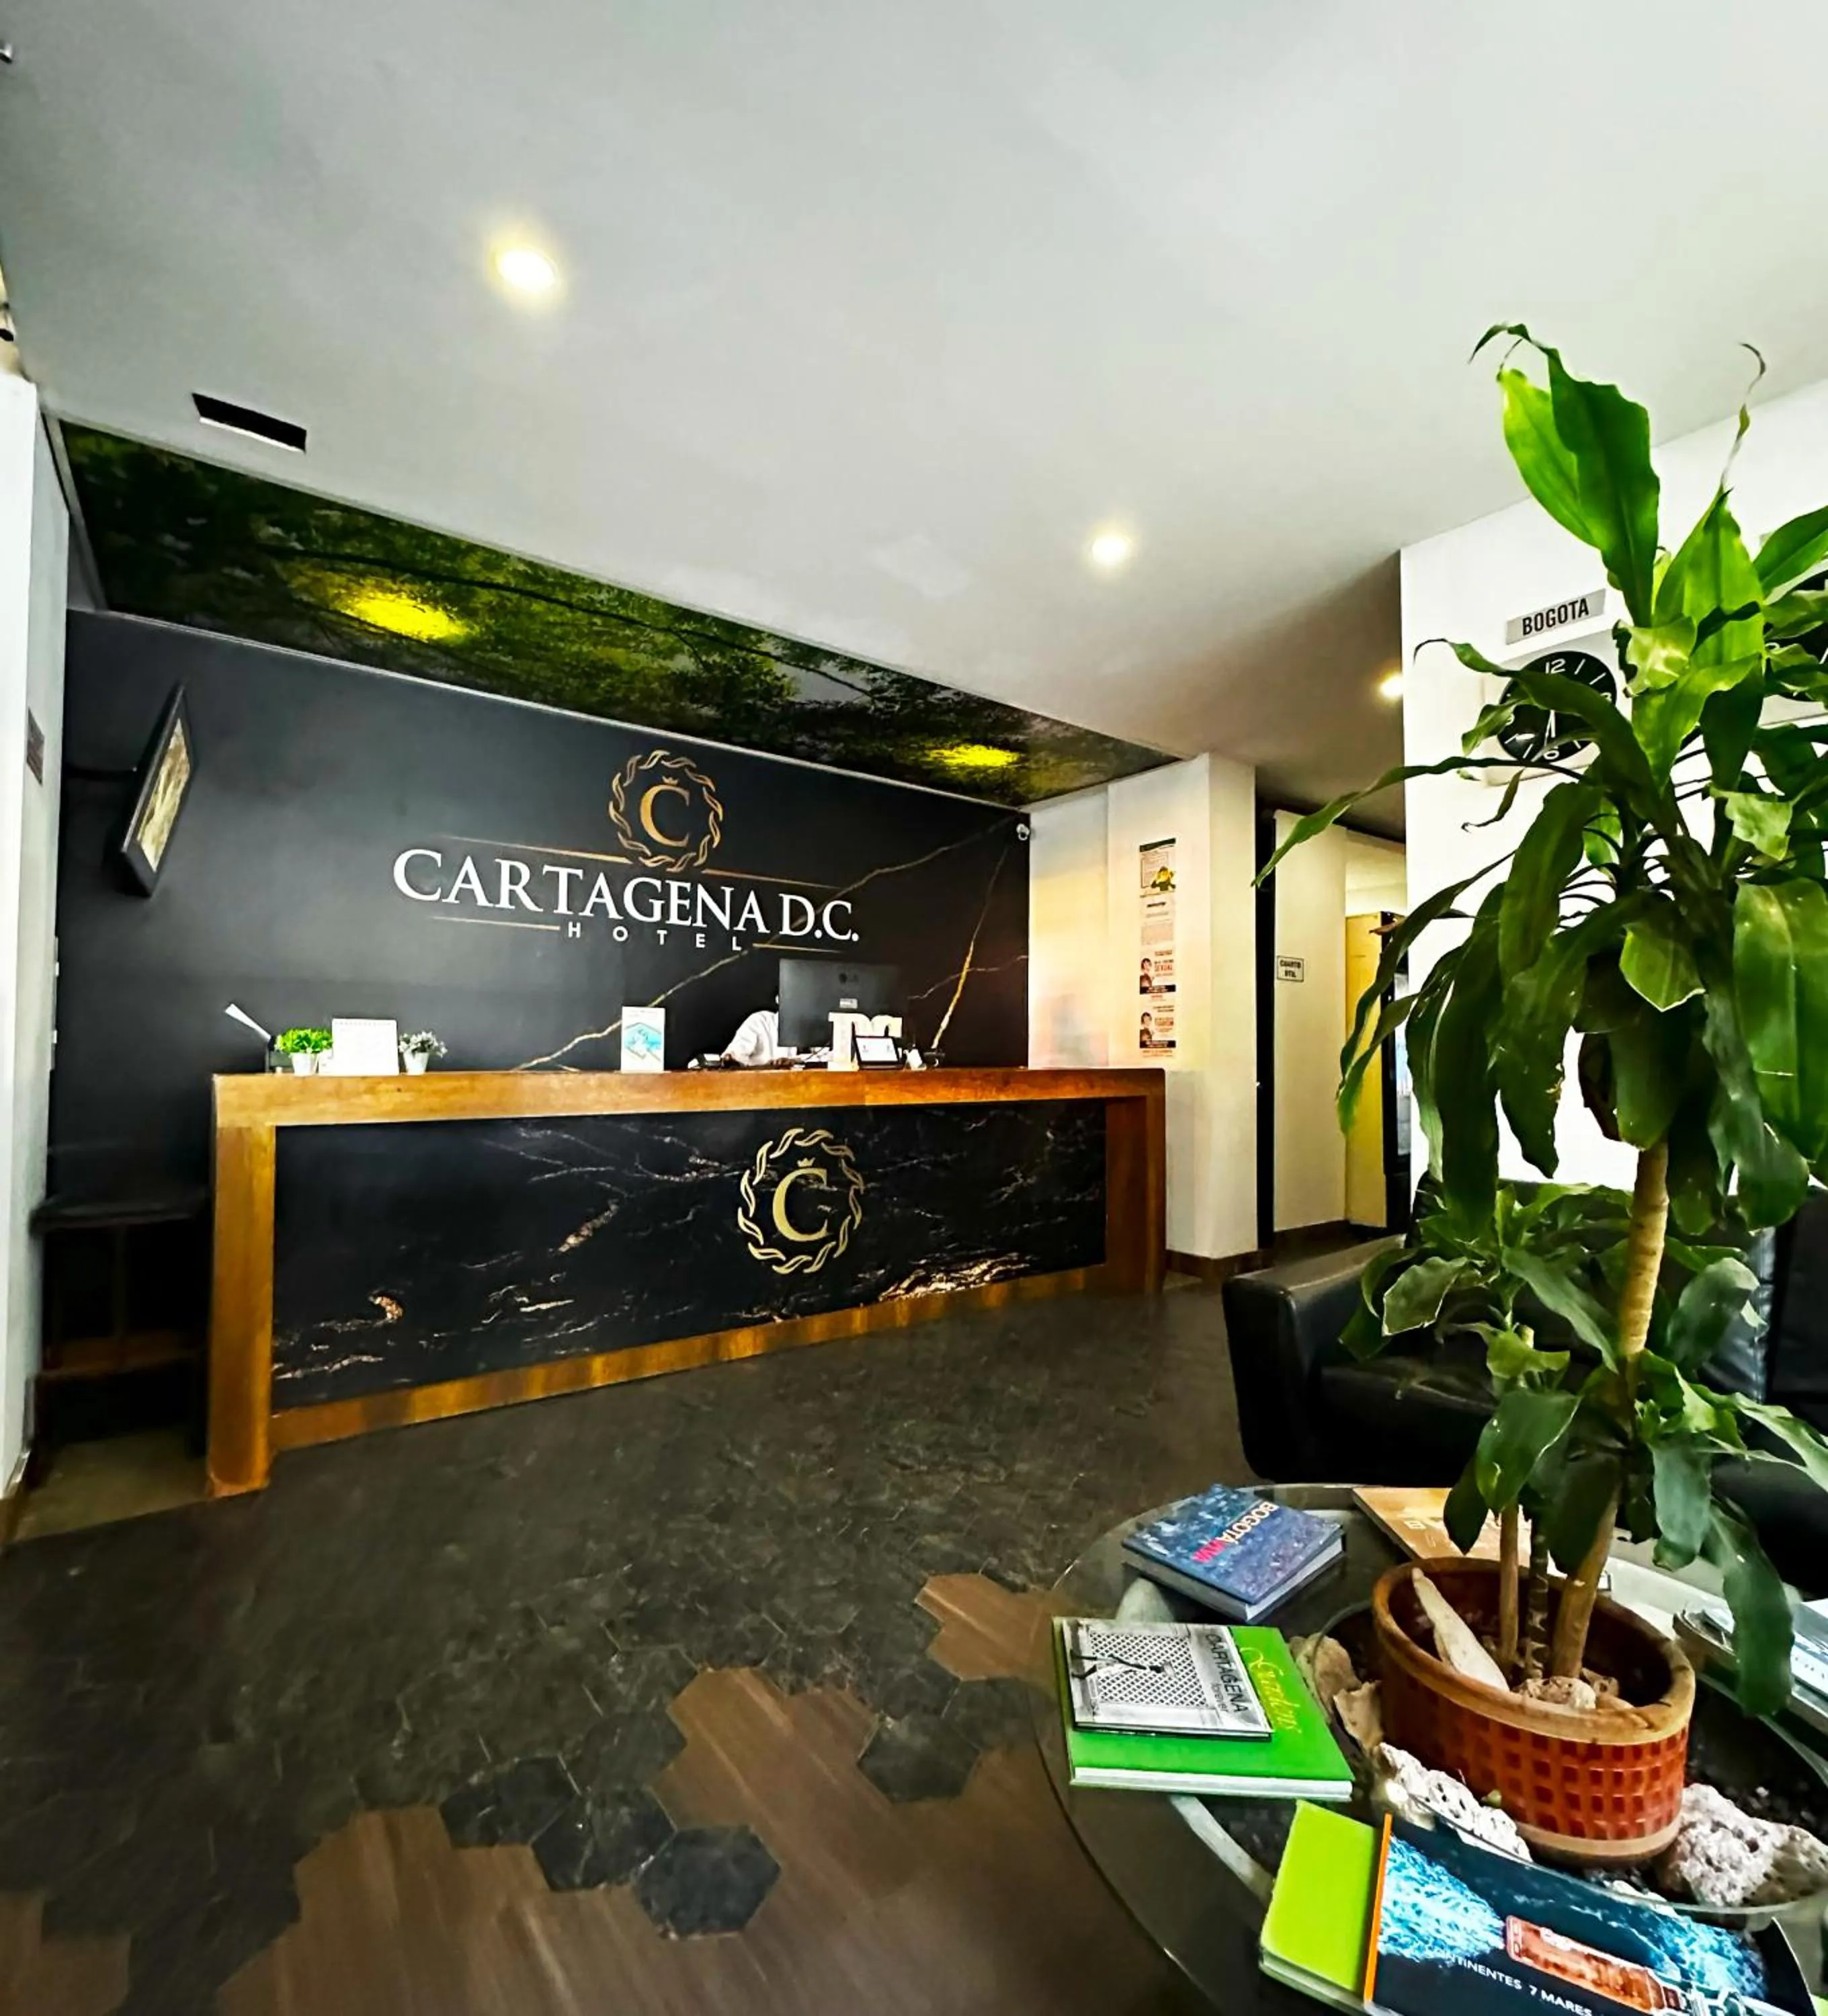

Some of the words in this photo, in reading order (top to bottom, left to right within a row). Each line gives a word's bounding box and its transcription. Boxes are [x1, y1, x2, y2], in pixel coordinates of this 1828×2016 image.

[1522, 597, 1589, 636] BOGOTA
[1546, 658, 1567, 674] 12
[640, 784, 690, 847] C
[392, 848, 770, 933] CARTAGENA
[778, 892, 860, 942] D.C.
[568, 921, 742, 952] HOTEL
[1205, 1634, 1249, 1712] CARTAGENA
[1529, 1984, 1538, 1996] 7
[1541, 1988, 1592, 2016] MARES
